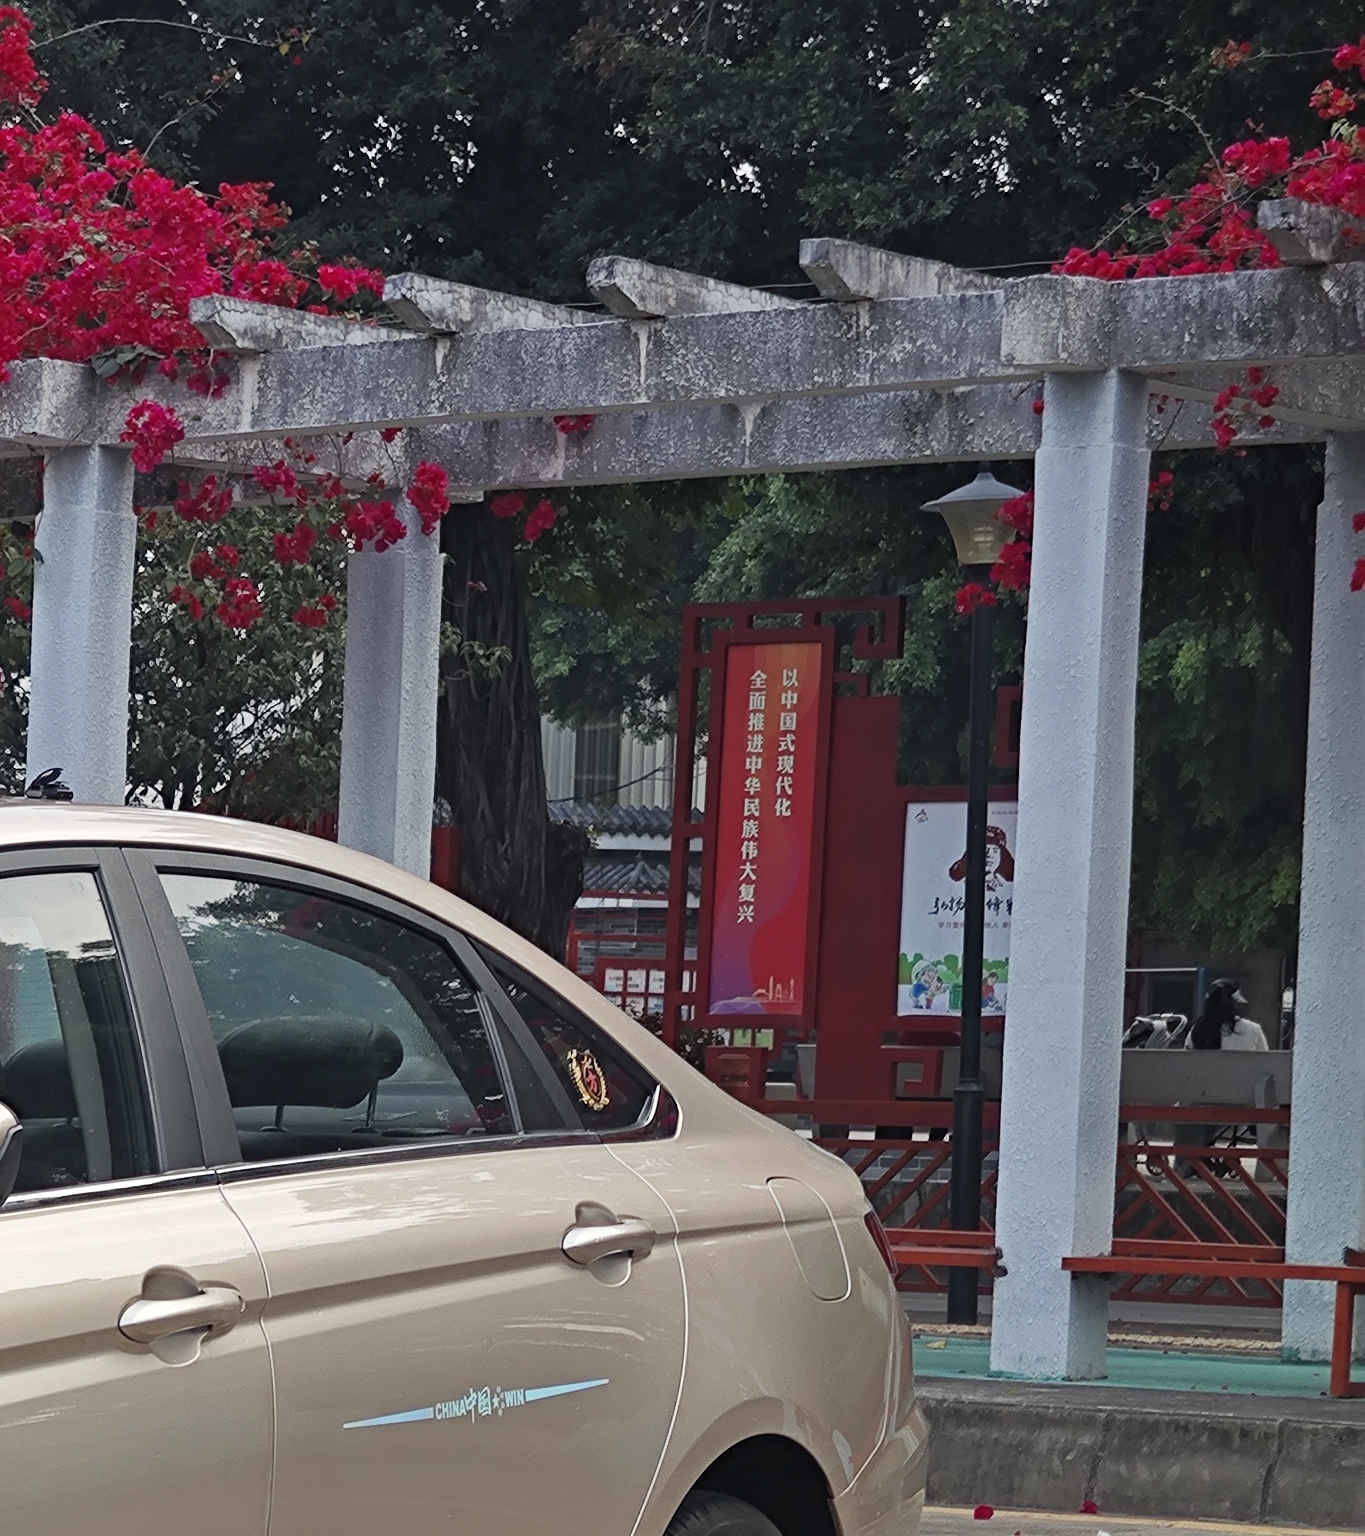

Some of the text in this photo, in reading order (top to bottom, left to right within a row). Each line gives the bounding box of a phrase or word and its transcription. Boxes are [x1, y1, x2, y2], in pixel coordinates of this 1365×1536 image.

[737, 669, 768, 924] 全面推进中华民族伟大复兴
[774, 668, 799, 817] 以中国式现代化
[504, 1388, 525, 1408] WIN
